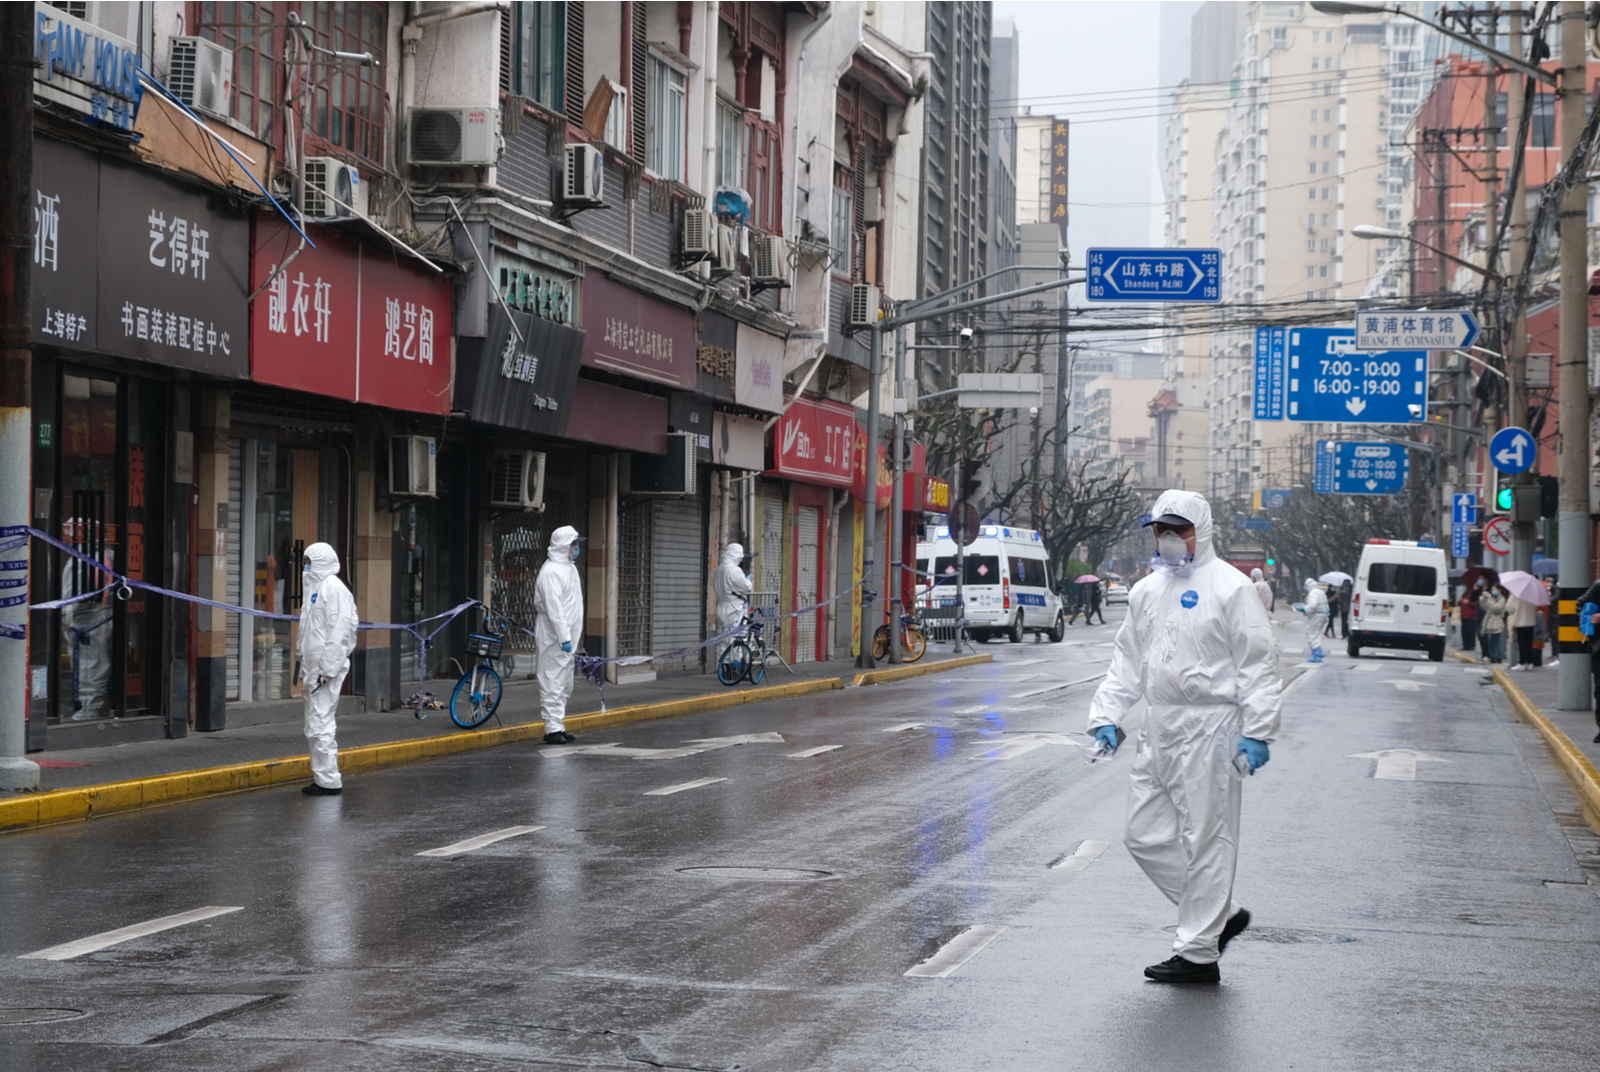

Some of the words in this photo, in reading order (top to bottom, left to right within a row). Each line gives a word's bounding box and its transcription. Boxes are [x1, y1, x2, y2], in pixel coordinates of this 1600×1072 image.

[148, 207, 210, 281] 艺得轩
[1201, 253, 1217, 265] 255
[1091, 266, 1102, 277] 南
[1122, 262, 1185, 277] 山东中路
[1206, 266, 1217, 278] 北
[1124, 279, 1160, 290] Shandong
[268, 263, 333, 344] 靓衣轩
[41, 306, 88, 342] 上海特产
[120, 300, 231, 356] 书画装裱配框中心
[1365, 316, 1455, 334] 黄浦体育馆
[1360, 335, 1388, 345] HUANG
[1392, 335, 1401, 345] PU
[1405, 335, 1456, 345] GYMNASIUM
[824, 424, 851, 470] 工厂店
